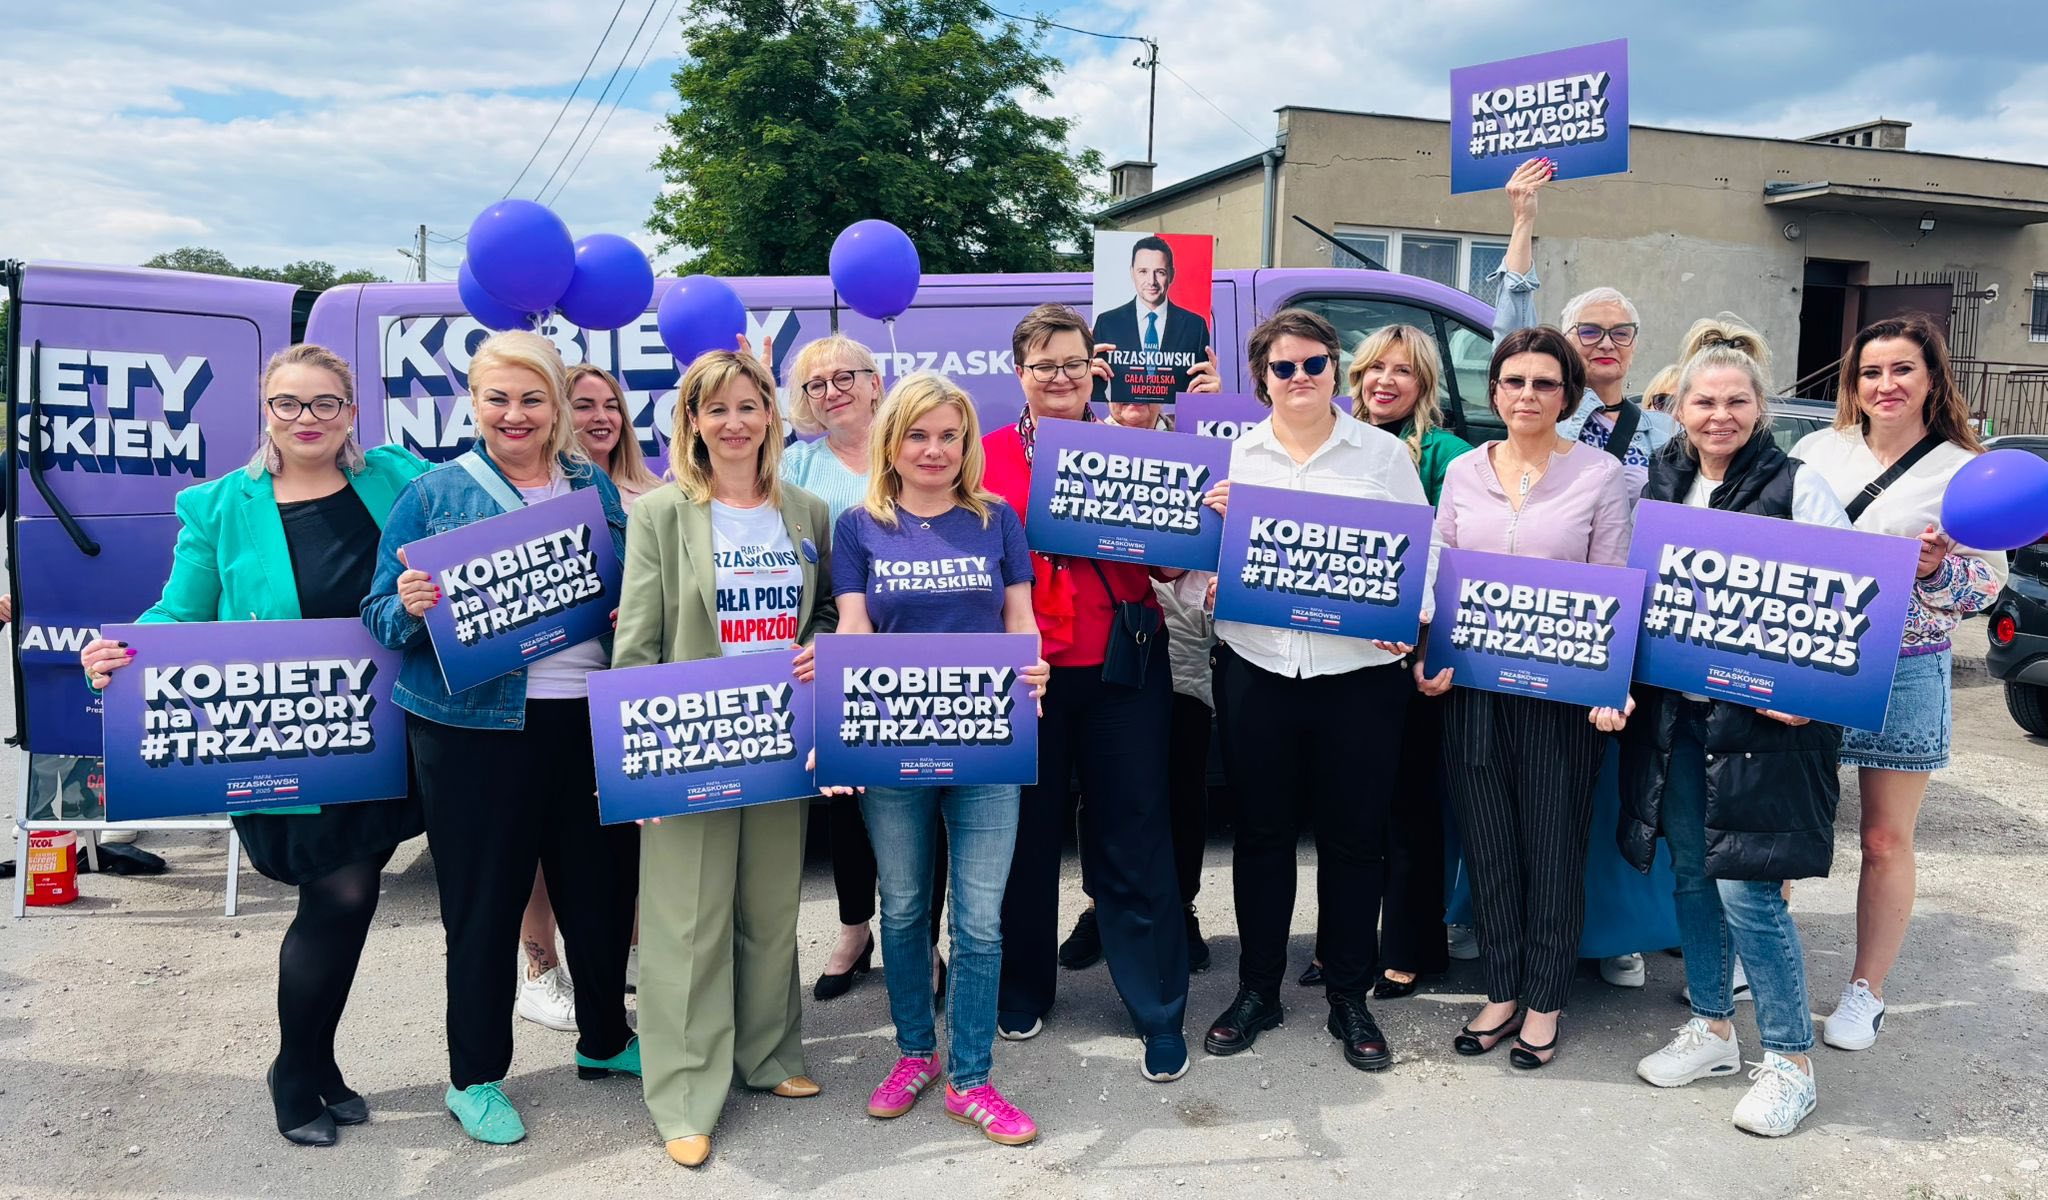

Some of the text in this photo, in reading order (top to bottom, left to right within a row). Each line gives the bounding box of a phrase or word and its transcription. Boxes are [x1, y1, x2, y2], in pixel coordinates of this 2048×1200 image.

[1472, 71, 1606, 115] KOBIETY
[1472, 97, 1606, 135] na WYBORY
[1469, 118, 1605, 154] #TRZA2025
[379, 307, 793, 377] KOBIEY
[1107, 350, 1195, 367] TRZASKOWSKI
[18, 346, 207, 412] IETY
[874, 350, 1014, 377] TRZASK
[1125, 374, 1175, 384] CAŁA POLSKA
[18, 414, 199, 460] SKIEM
[1057, 448, 1207, 488] KOBIETY
[1055, 478, 1204, 508] na WYBORY
[1049, 495, 1199, 530] #TRZA2025
[1250, 516, 1408, 557] KOBIETY
[440, 523, 586, 596] KOBIETY
[874, 557, 986, 577] KOBIETY
[1247, 546, 1403, 579] na WYBORY
[1660, 544, 1875, 608] KOBIETY
[451, 551, 593, 618] na WYBORY
[716, 588, 750, 612] AŁA
[875, 583, 882, 593] z
[887, 574, 992, 591] TRZASKIEM
[1241, 564, 1398, 601] #TRZA2025
[1460, 578, 1616, 620] KOBIETY
[455, 572, 601, 642] #TRZA2025
[1292, 609, 1341, 620] TRZASKOWSKI
[1456, 608, 1612, 642] na WYBORY
[1653, 583, 1868, 637] na WYBORY
[1451, 625, 1607, 665] #TRZA2025
[1644, 605, 1857, 667] #TRZA2025
[145, 659, 371, 700] KOBIETY
[843, 666, 1011, 694] KOBIETY
[1709, 668, 1774, 687] TRZASKOWSKI
[145, 694, 370, 729] na WYBORY
[620, 682, 788, 727] KOBIETY
[843, 696, 1011, 716] na WYBORY
[140, 721, 371, 761] #TRZA2025
[623, 710, 790, 750] na WYBORY
[839, 718, 1010, 740] #TRZA2025
[622, 733, 793, 774] #TRZA2025
[227, 778, 298, 789] TRZASKOWSKI
[687, 782, 741, 794] TRZASKOWSKI
